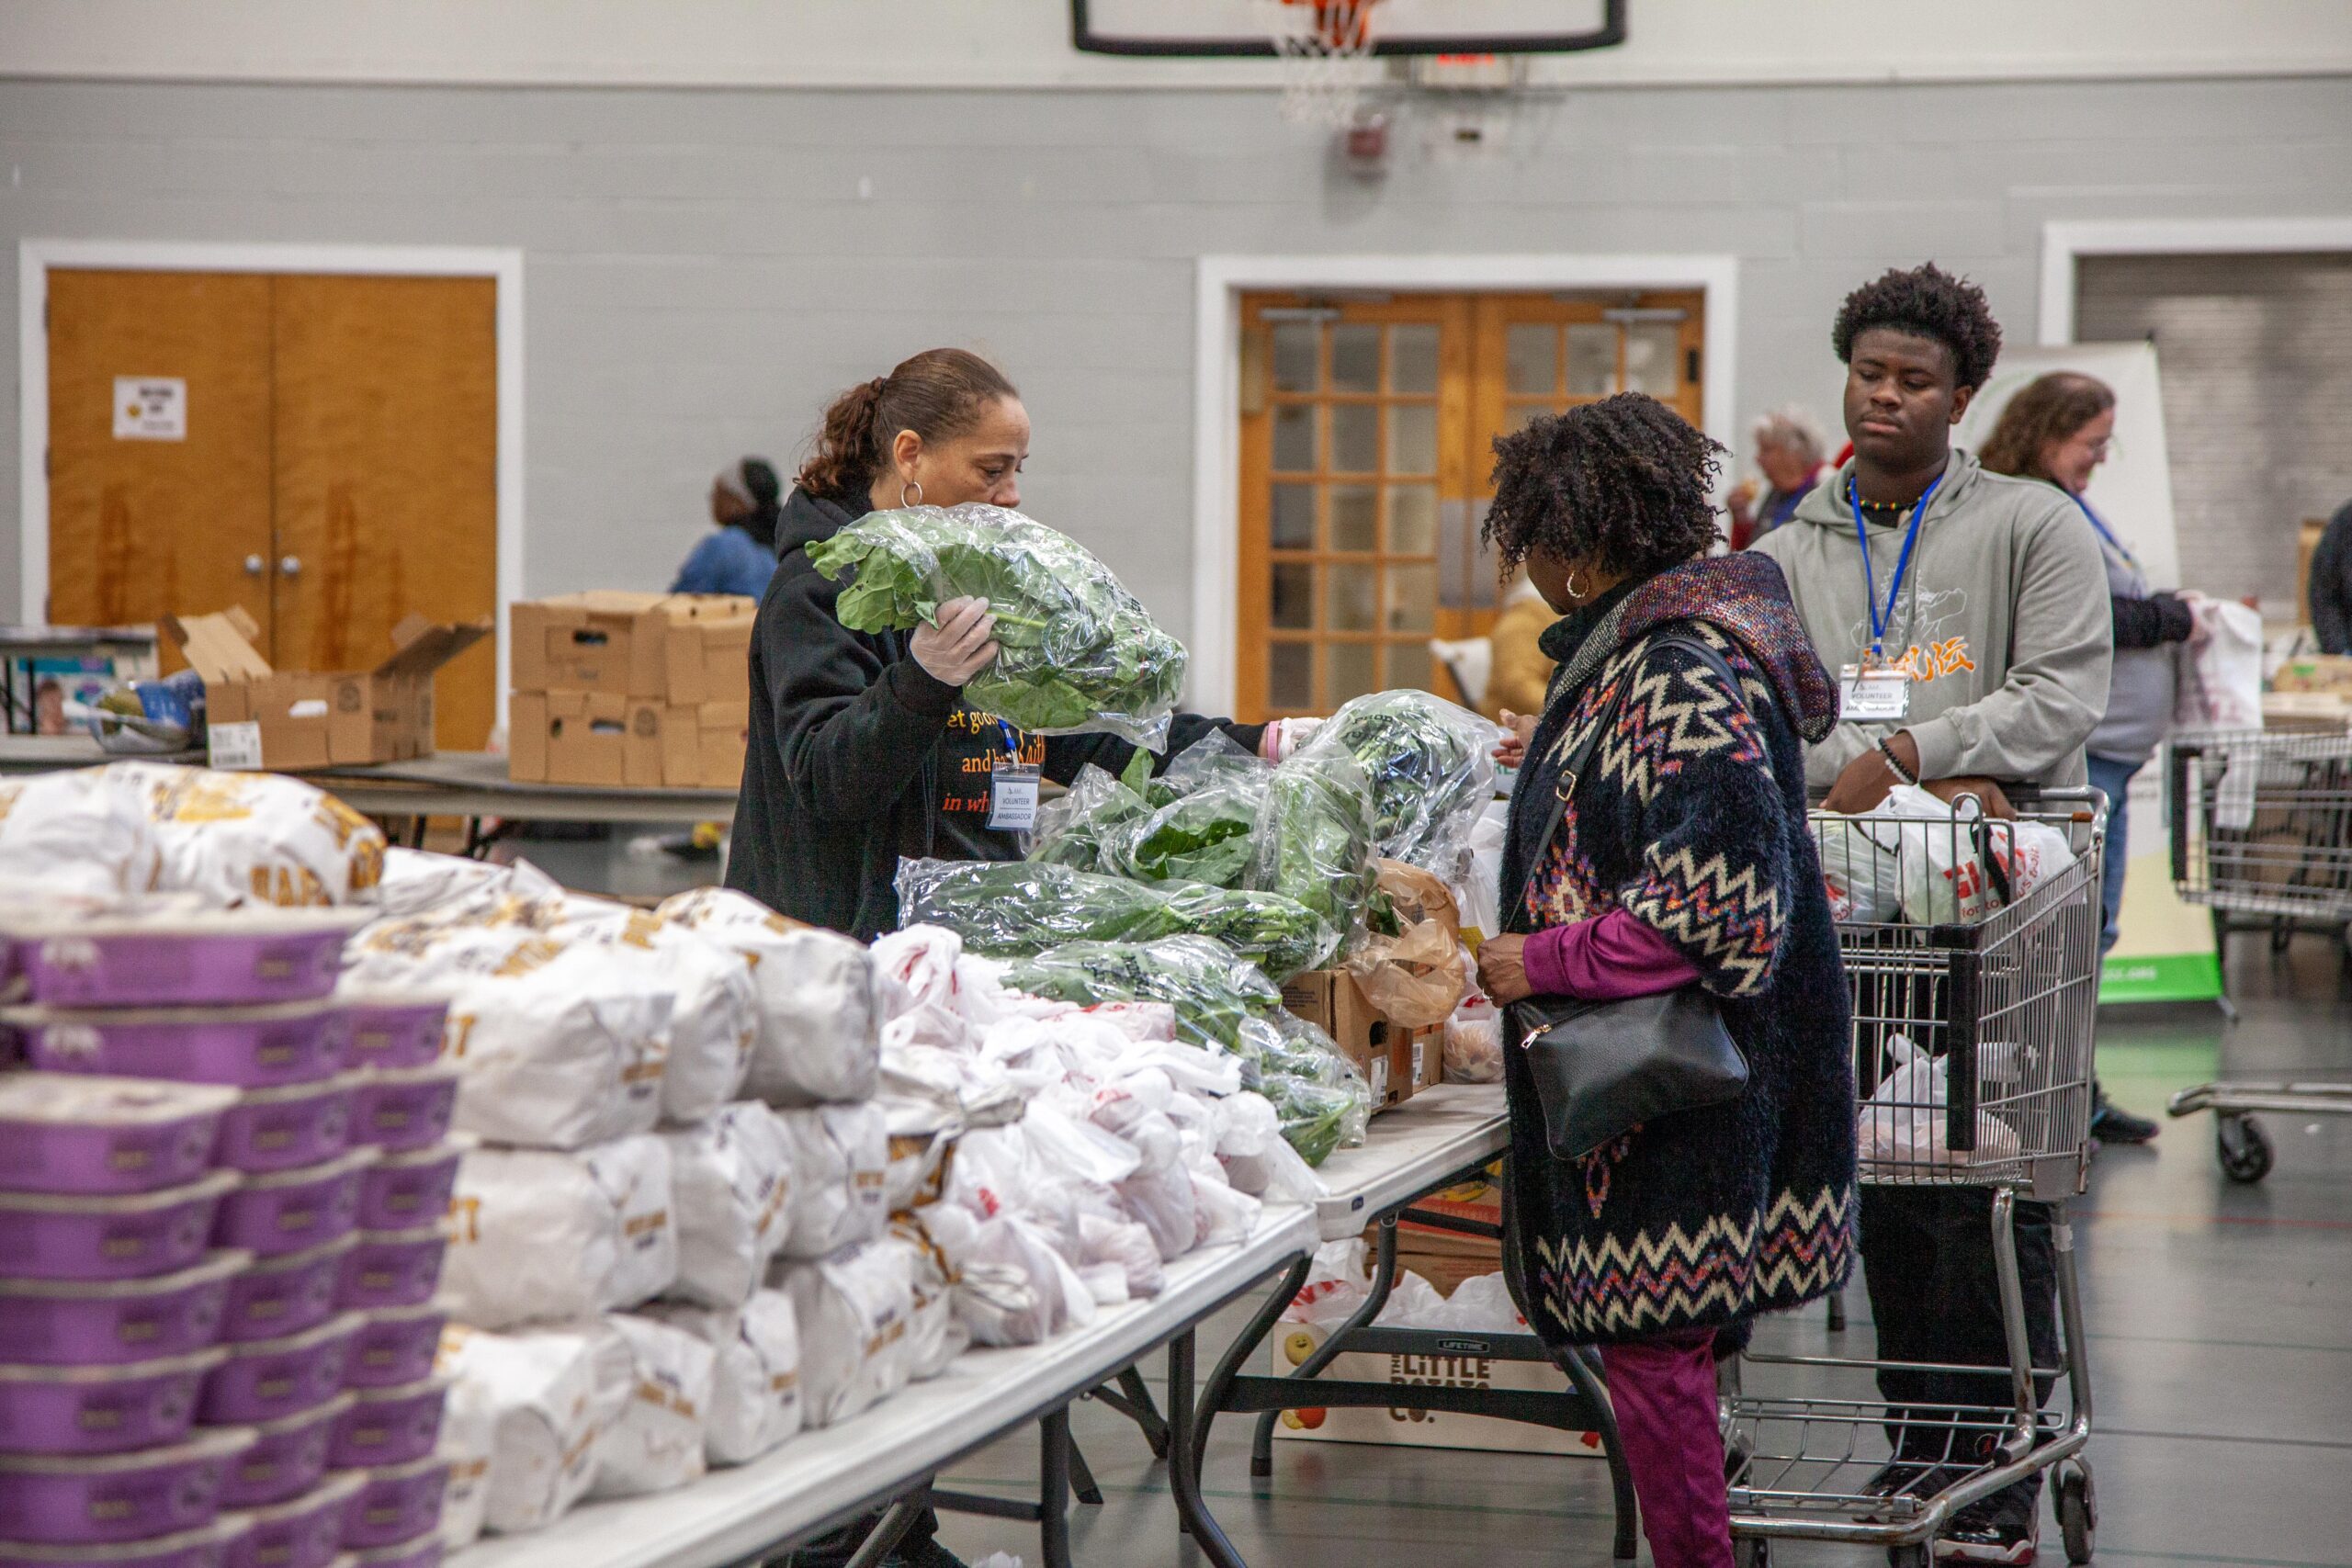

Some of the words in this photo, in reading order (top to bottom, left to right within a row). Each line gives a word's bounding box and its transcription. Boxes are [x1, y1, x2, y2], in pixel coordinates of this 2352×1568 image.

[961, 749, 991, 773] and
[943, 793, 961, 811] in
[1002, 797, 1030, 806] VOLUNTEER
[998, 812, 1032, 820] AMBASSADOR
[1442, 1341, 1484, 1350] LIFETIME
